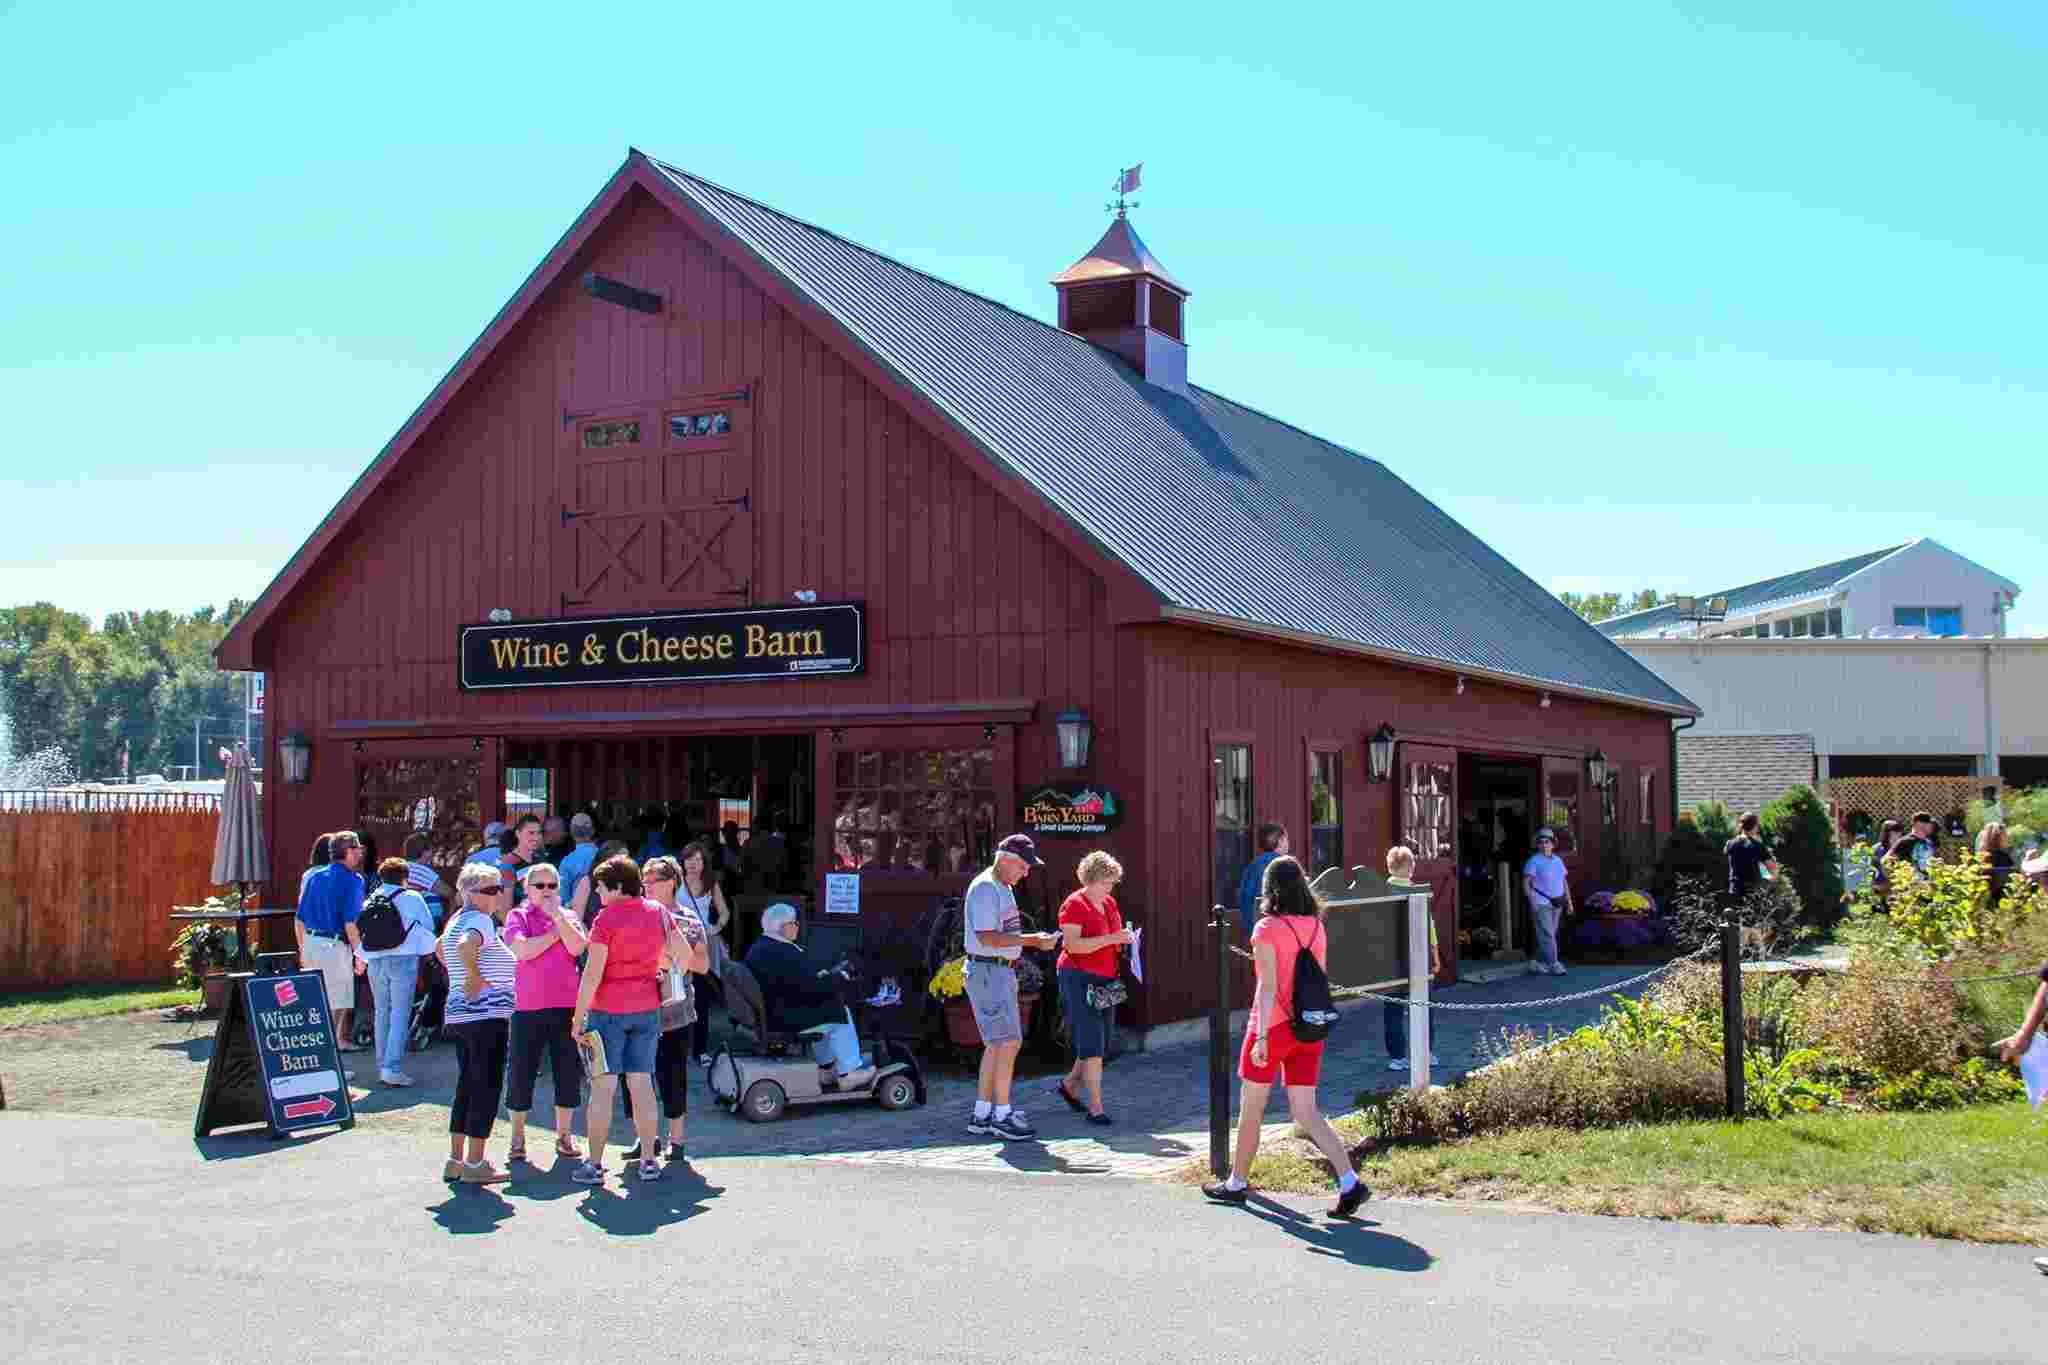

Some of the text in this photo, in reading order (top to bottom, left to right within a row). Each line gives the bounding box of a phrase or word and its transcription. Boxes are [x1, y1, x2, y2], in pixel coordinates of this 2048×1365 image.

[490, 625, 825, 668] Wine & Cheese Barn
[1024, 807, 1095, 823] BARN YARD
[260, 1007, 321, 1030] Wine &
[266, 1031, 325, 1051] Cheese
[280, 1054, 320, 1072] Barn
